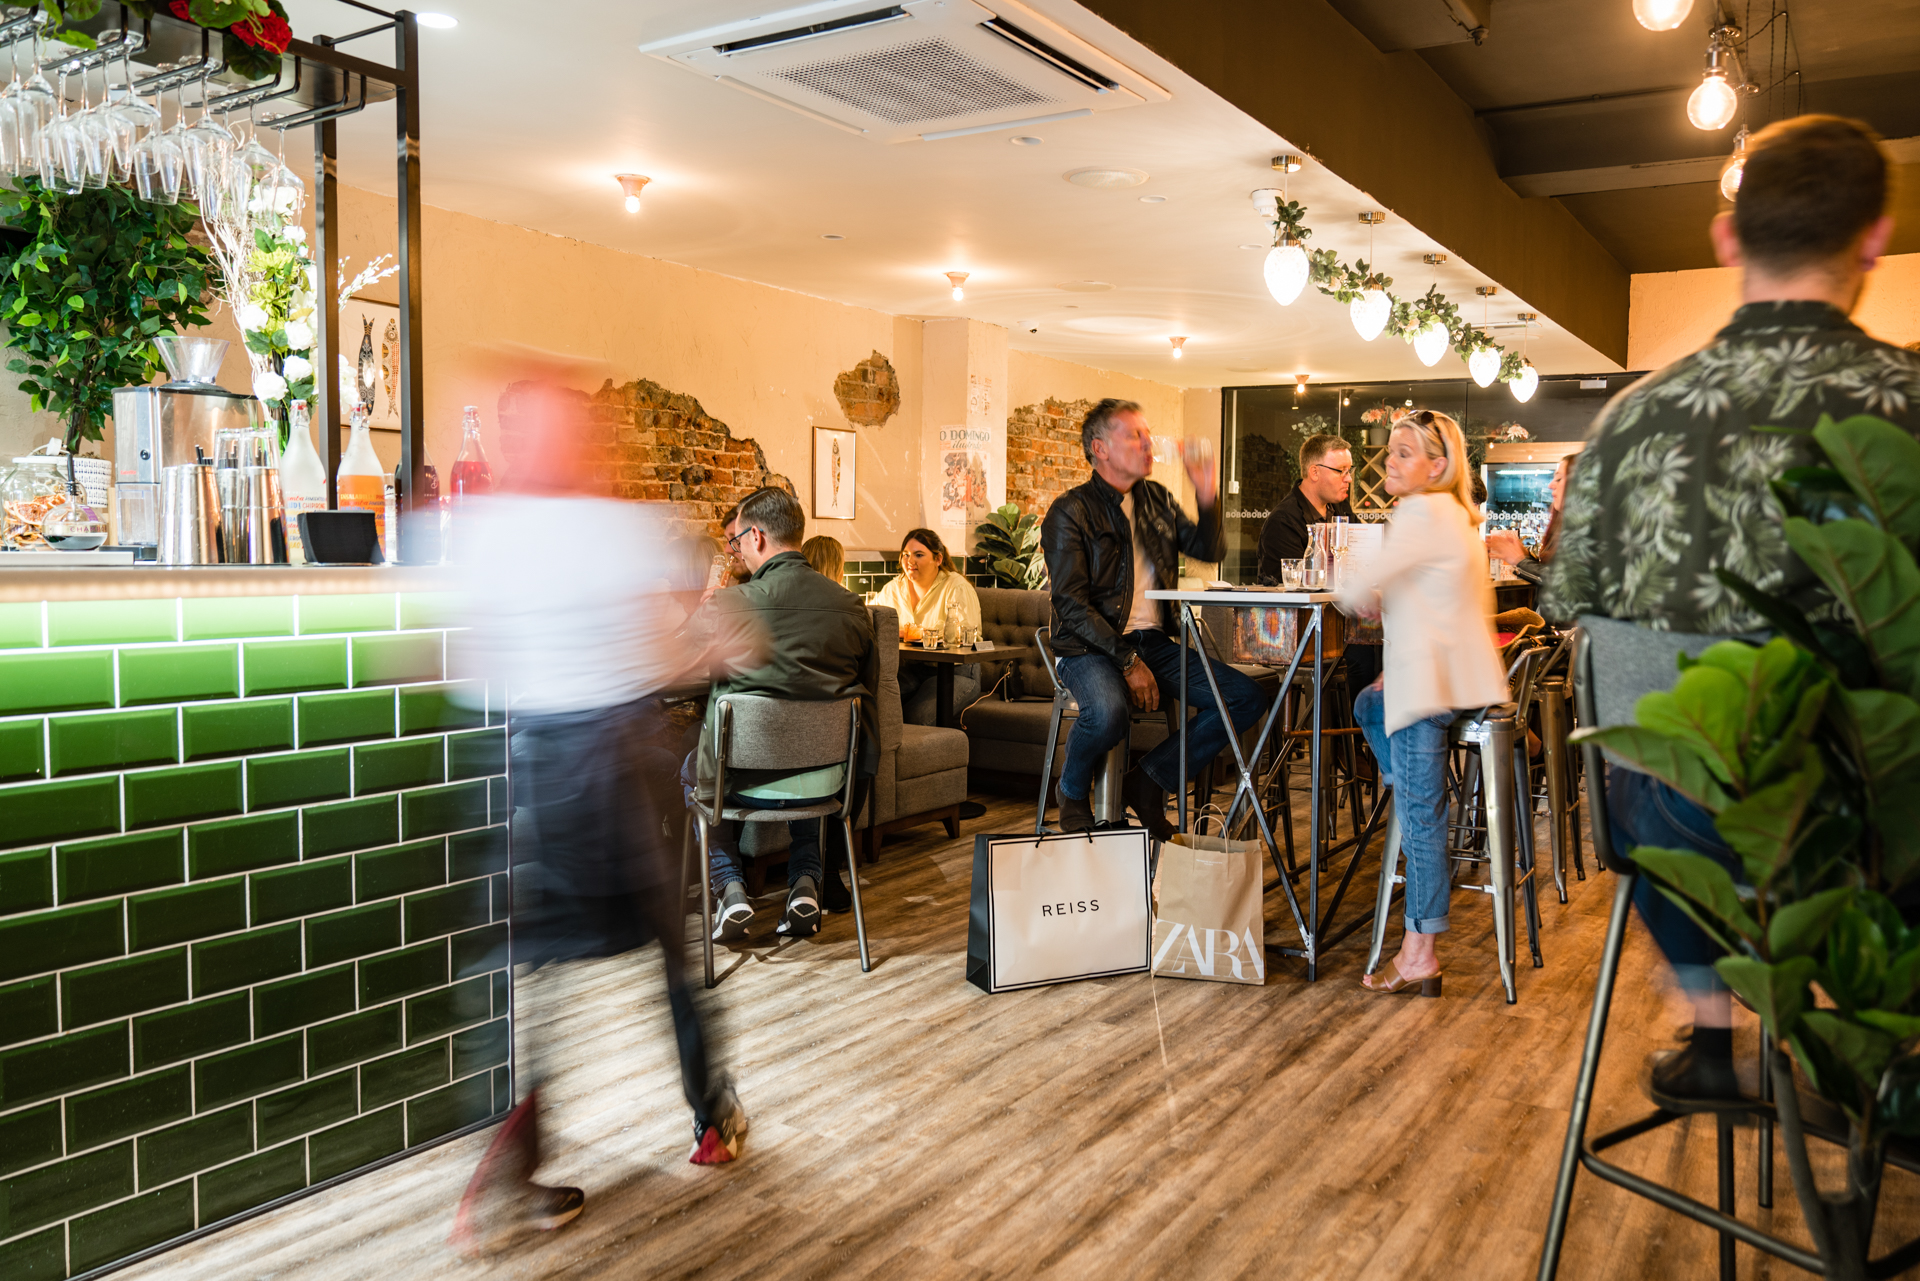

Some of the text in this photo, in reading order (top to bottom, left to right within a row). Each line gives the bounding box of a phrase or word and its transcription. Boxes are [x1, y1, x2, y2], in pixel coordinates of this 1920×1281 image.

[950, 429, 990, 441] DOMINGO
[1042, 899, 1100, 917] REISS
[1152, 918, 1265, 980] ZARA
